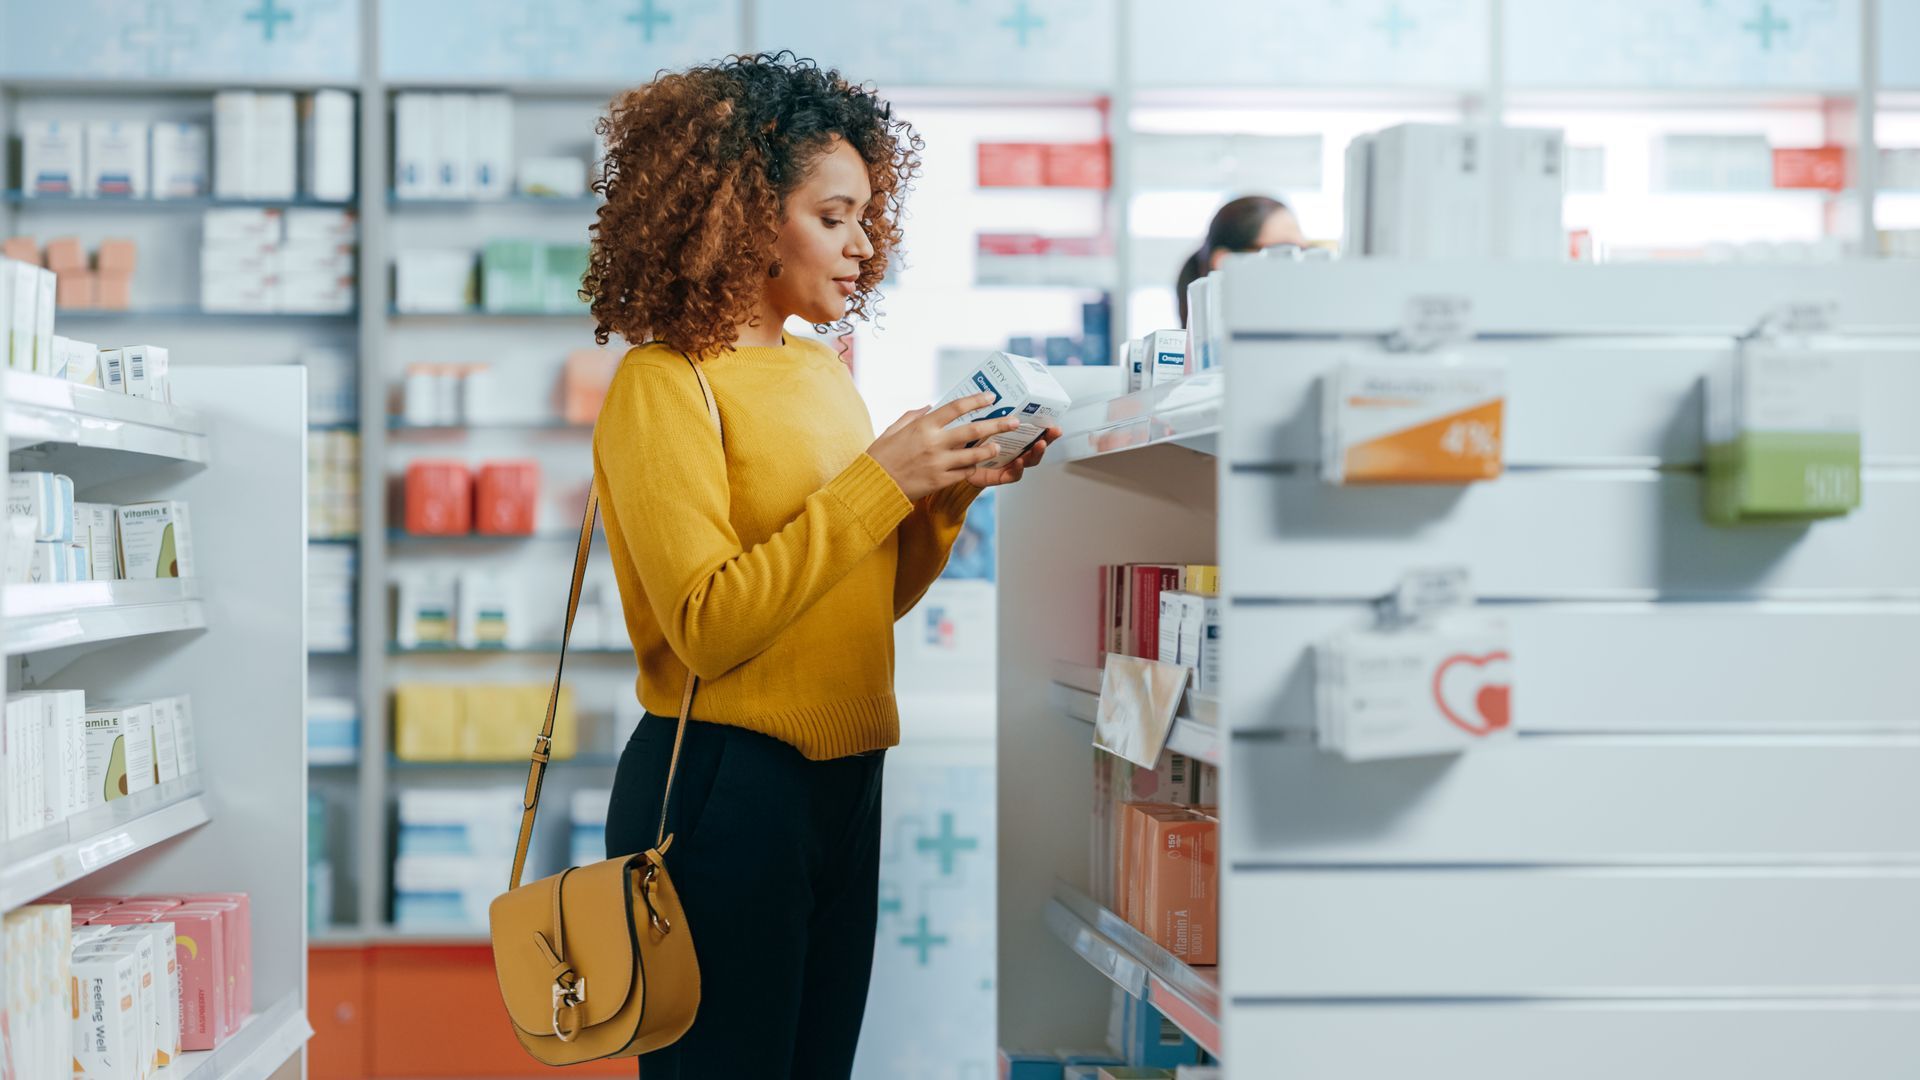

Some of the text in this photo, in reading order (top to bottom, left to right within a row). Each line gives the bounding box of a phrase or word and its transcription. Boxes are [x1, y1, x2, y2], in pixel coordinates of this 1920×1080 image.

[986, 359, 1007, 383] FATTY
[123, 507, 168, 518] Vitamin E
[85, 717, 119, 728] amin E
[1174, 919, 1187, 956] Vitamin
[92, 978, 107, 1052] Feeling Well
